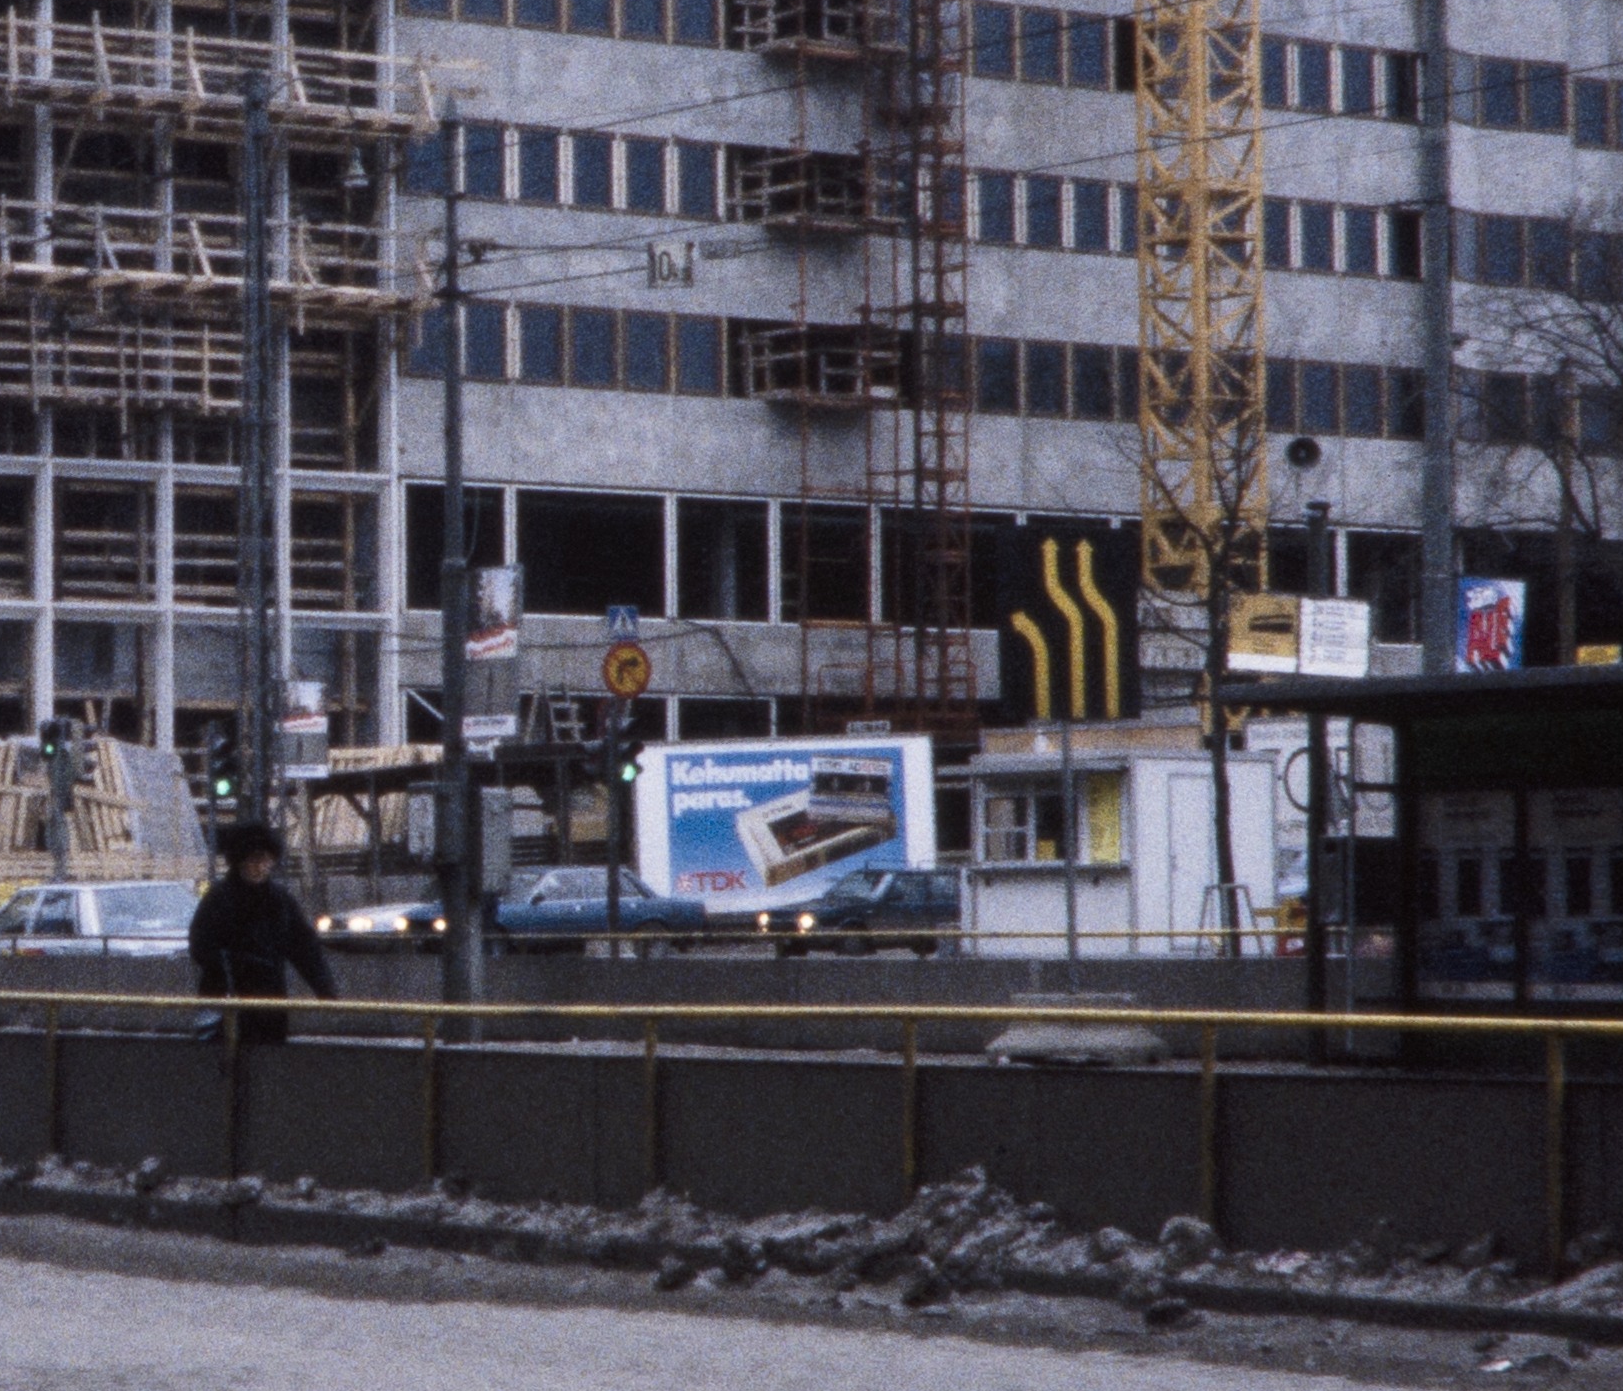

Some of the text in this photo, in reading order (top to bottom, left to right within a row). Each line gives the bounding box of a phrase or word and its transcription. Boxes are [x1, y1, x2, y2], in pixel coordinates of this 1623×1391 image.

[670, 756, 810, 787] Kehumatta
[672, 787, 752, 818] paras.
[694, 870, 747, 893] TDK
